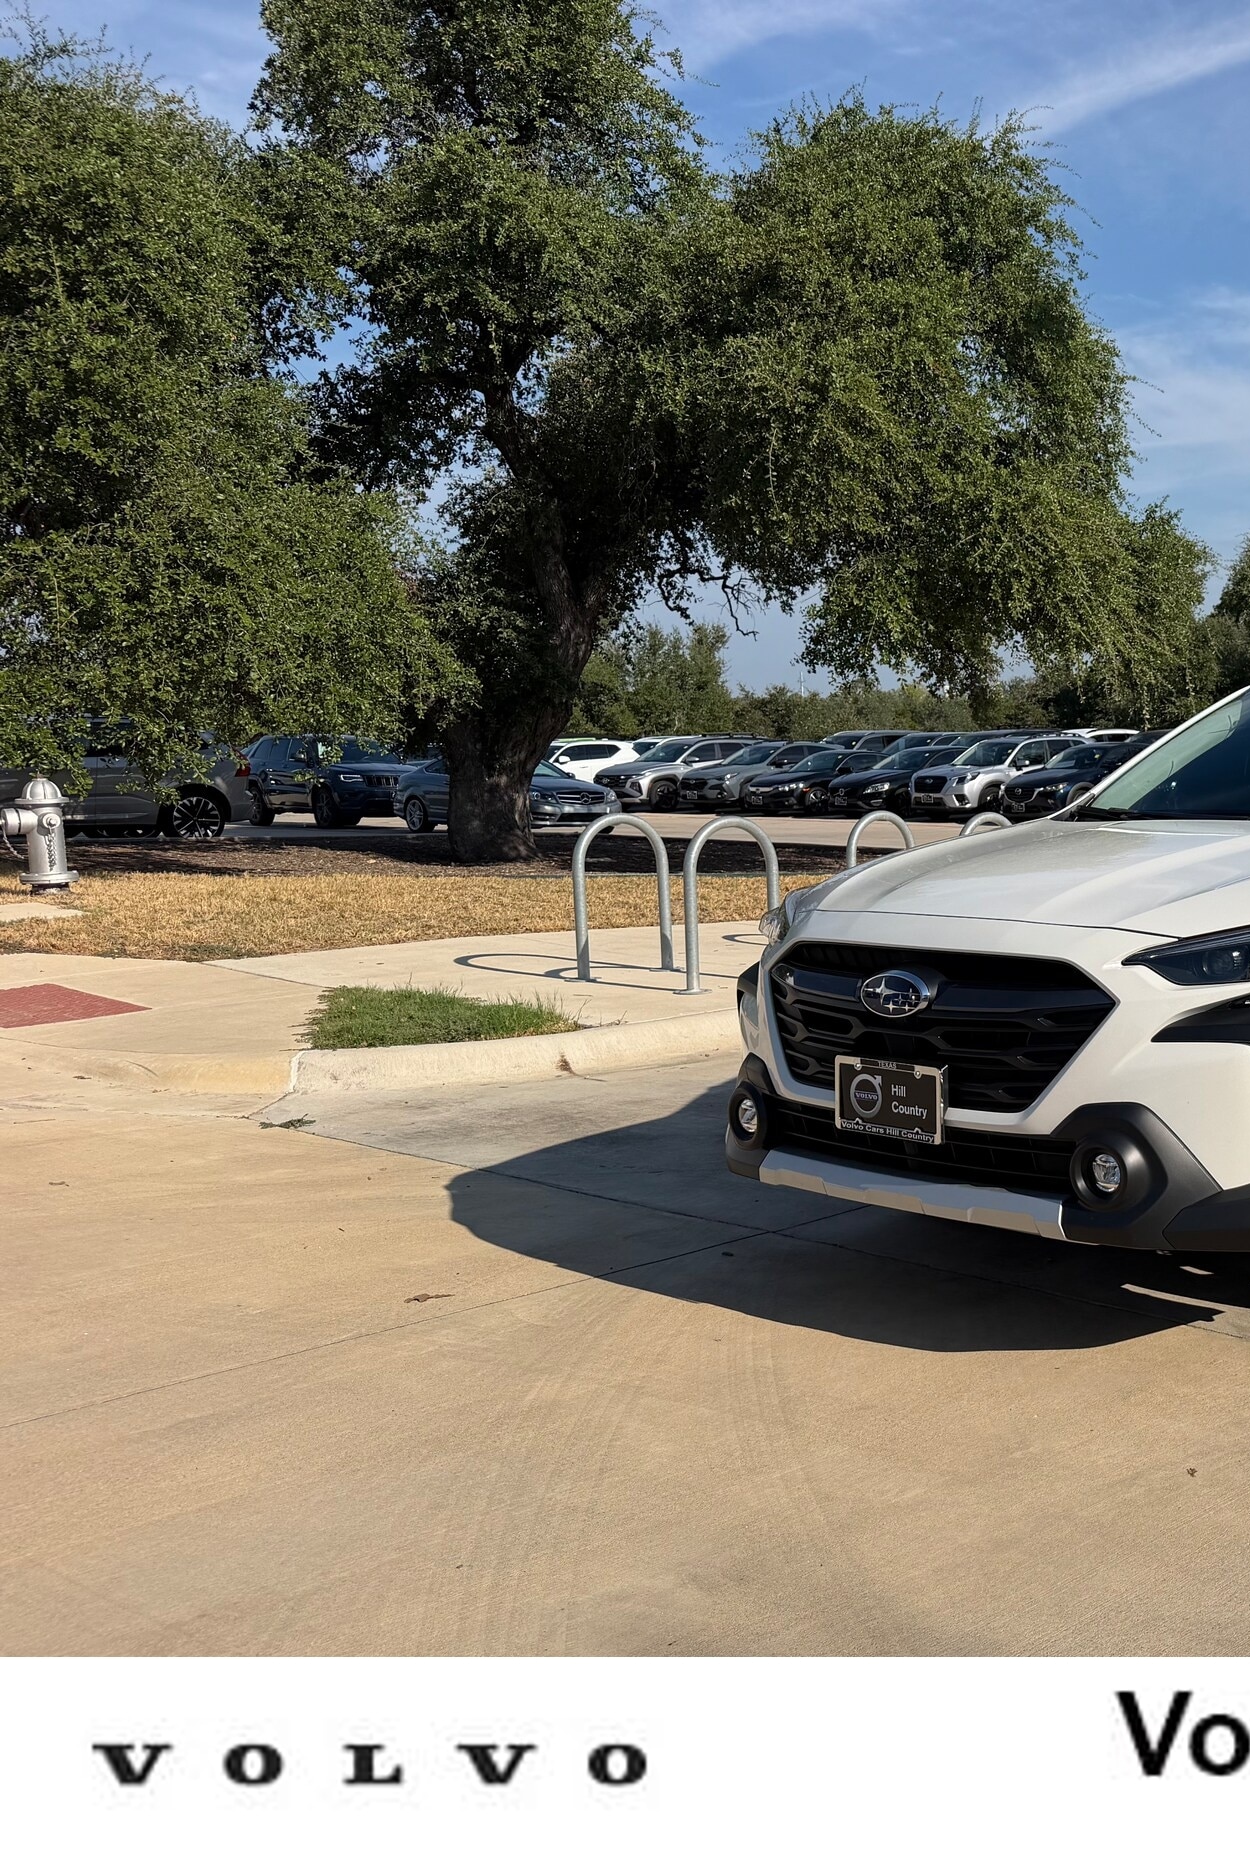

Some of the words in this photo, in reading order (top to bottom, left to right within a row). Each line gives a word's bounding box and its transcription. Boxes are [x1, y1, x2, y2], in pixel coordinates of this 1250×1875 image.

[878, 1061, 897, 1070] TEXAS
[855, 1091, 878, 1101] VOLVO
[891, 1084, 906, 1098] Hill
[891, 1101, 928, 1120] Country
[841, 1120, 864, 1131] Volvo
[866, 1125, 885, 1134] Cars
[886, 1128, 900, 1137] Hill
[901, 1130, 934, 1143] Country
